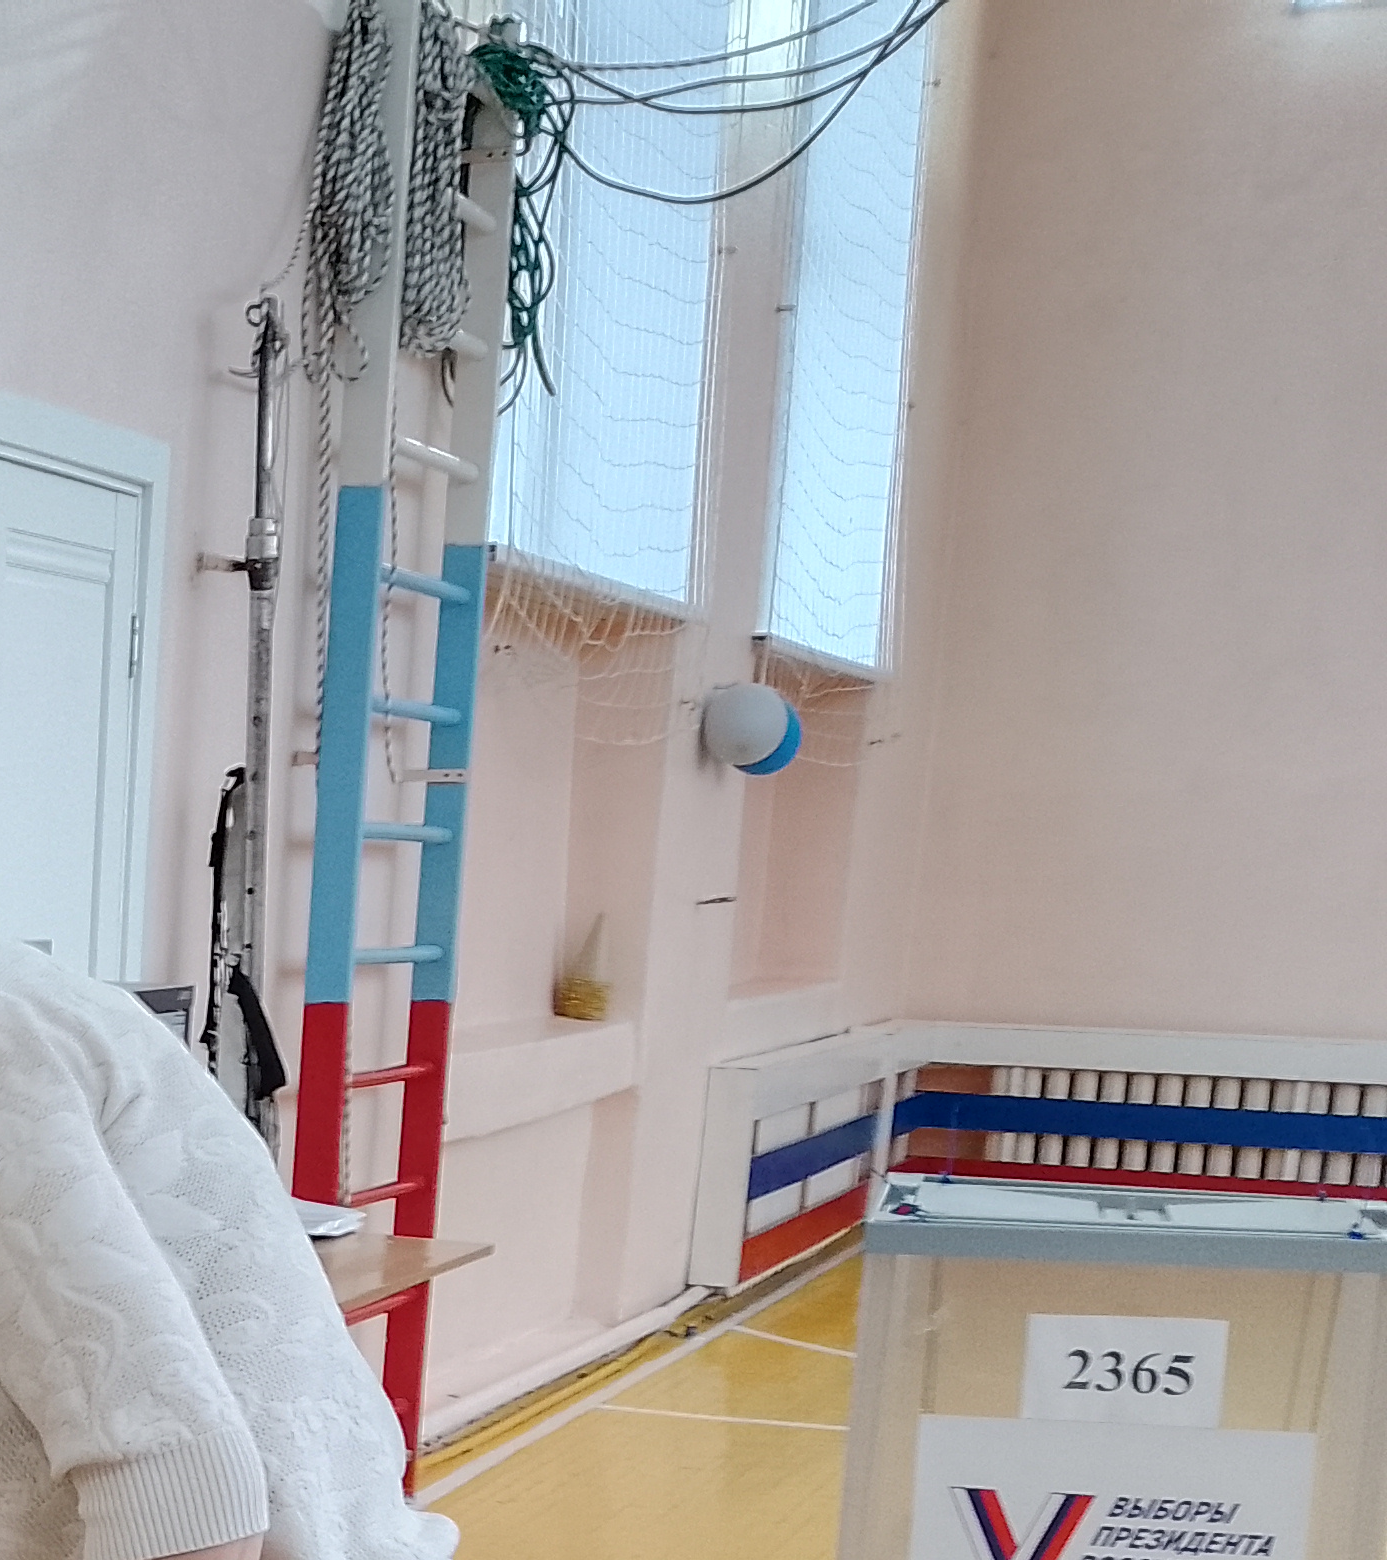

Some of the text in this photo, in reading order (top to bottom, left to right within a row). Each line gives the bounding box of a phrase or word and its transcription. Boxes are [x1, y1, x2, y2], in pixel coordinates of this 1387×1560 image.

[1062, 1349, 1196, 1396] 2365
[1107, 1496, 1241, 1524] ВЫБОРЫ
[1090, 1526, 1276, 1557] ПРЕЗИДЕНТА
